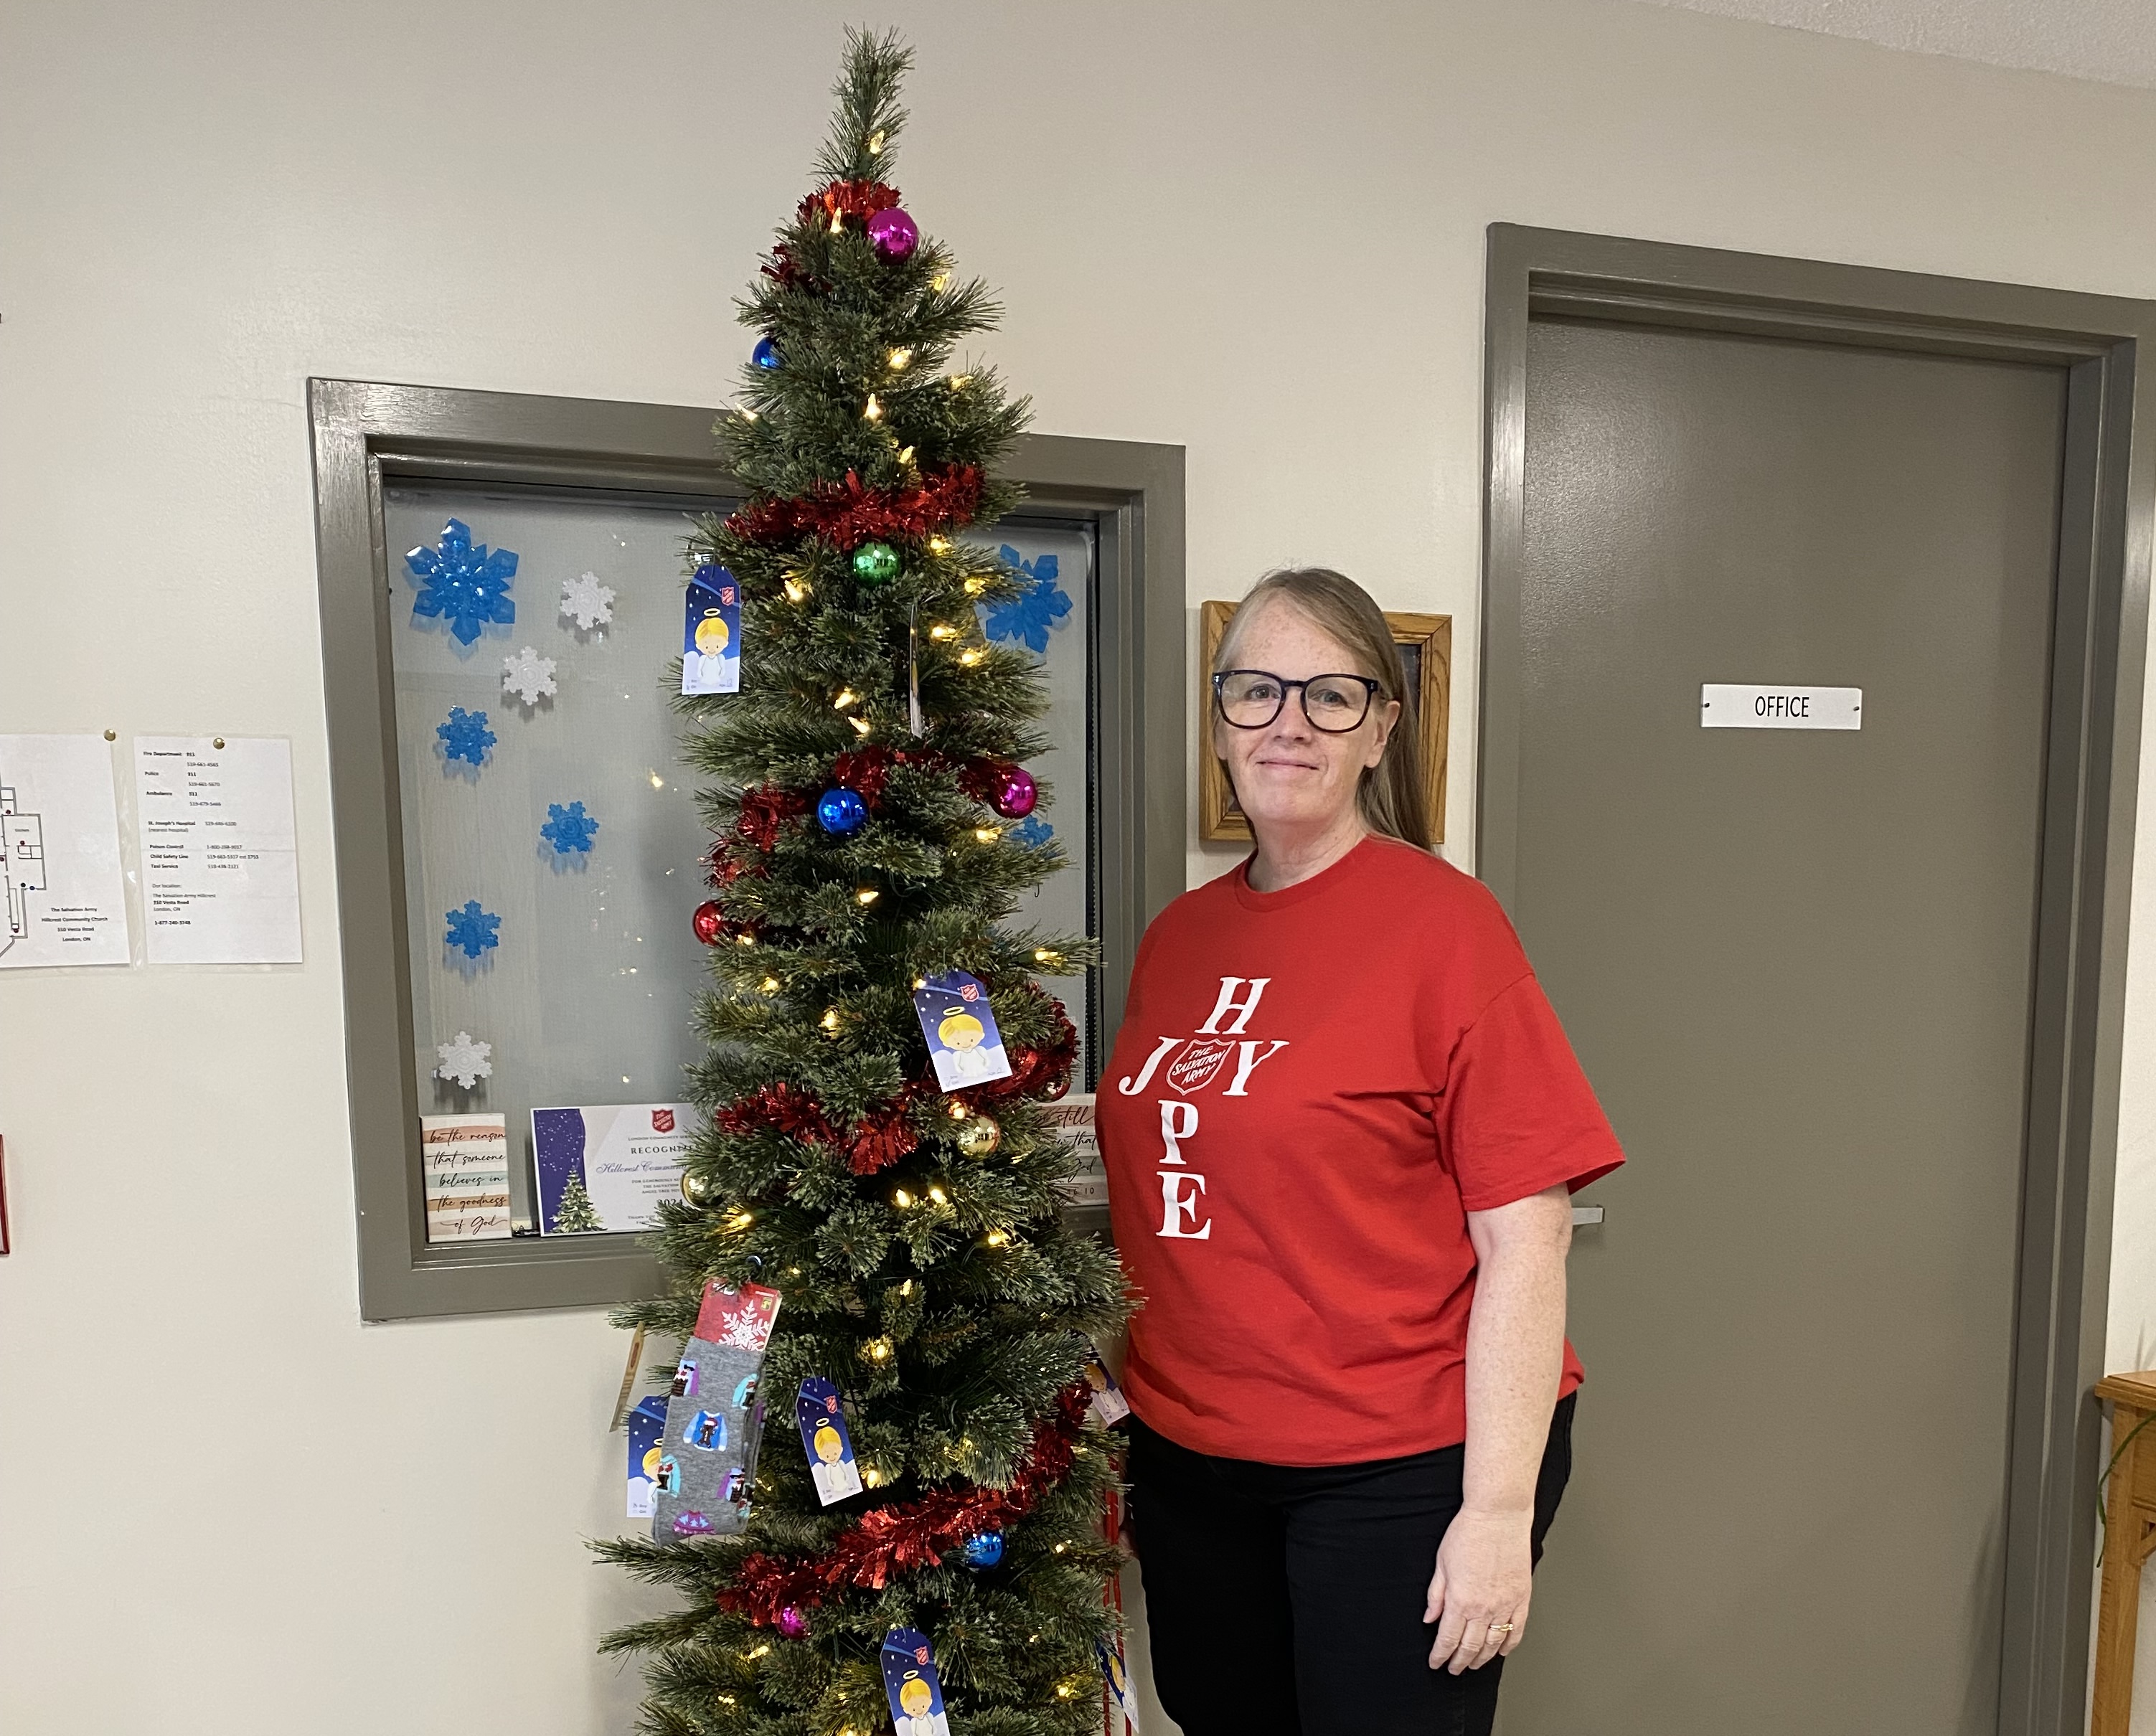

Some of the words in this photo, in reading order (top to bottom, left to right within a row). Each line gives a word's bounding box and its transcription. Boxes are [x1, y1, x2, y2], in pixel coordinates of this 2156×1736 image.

[1755, 696, 1809, 717] OFFICE
[1172, 1049, 1226, 1076] SALVATION
[1188, 1045, 1214, 1060] THE
[1181, 1063, 1217, 1085] ARMY
[1054, 1105, 1095, 1129] still
[430, 1131, 444, 1143] be
[440, 1129, 466, 1146] the
[470, 1132, 507, 1143] reason
[426, 1151, 466, 1169] that
[462, 1154, 506, 1166] someone
[596, 1162, 639, 1174] Hillcrest
[439, 1173, 486, 1187] believes
[429, 1194, 455, 1212] the
[459, 1192, 507, 1212] goodness
[441, 1220, 466, 1234] of
[471, 1215, 508, 1235] God
